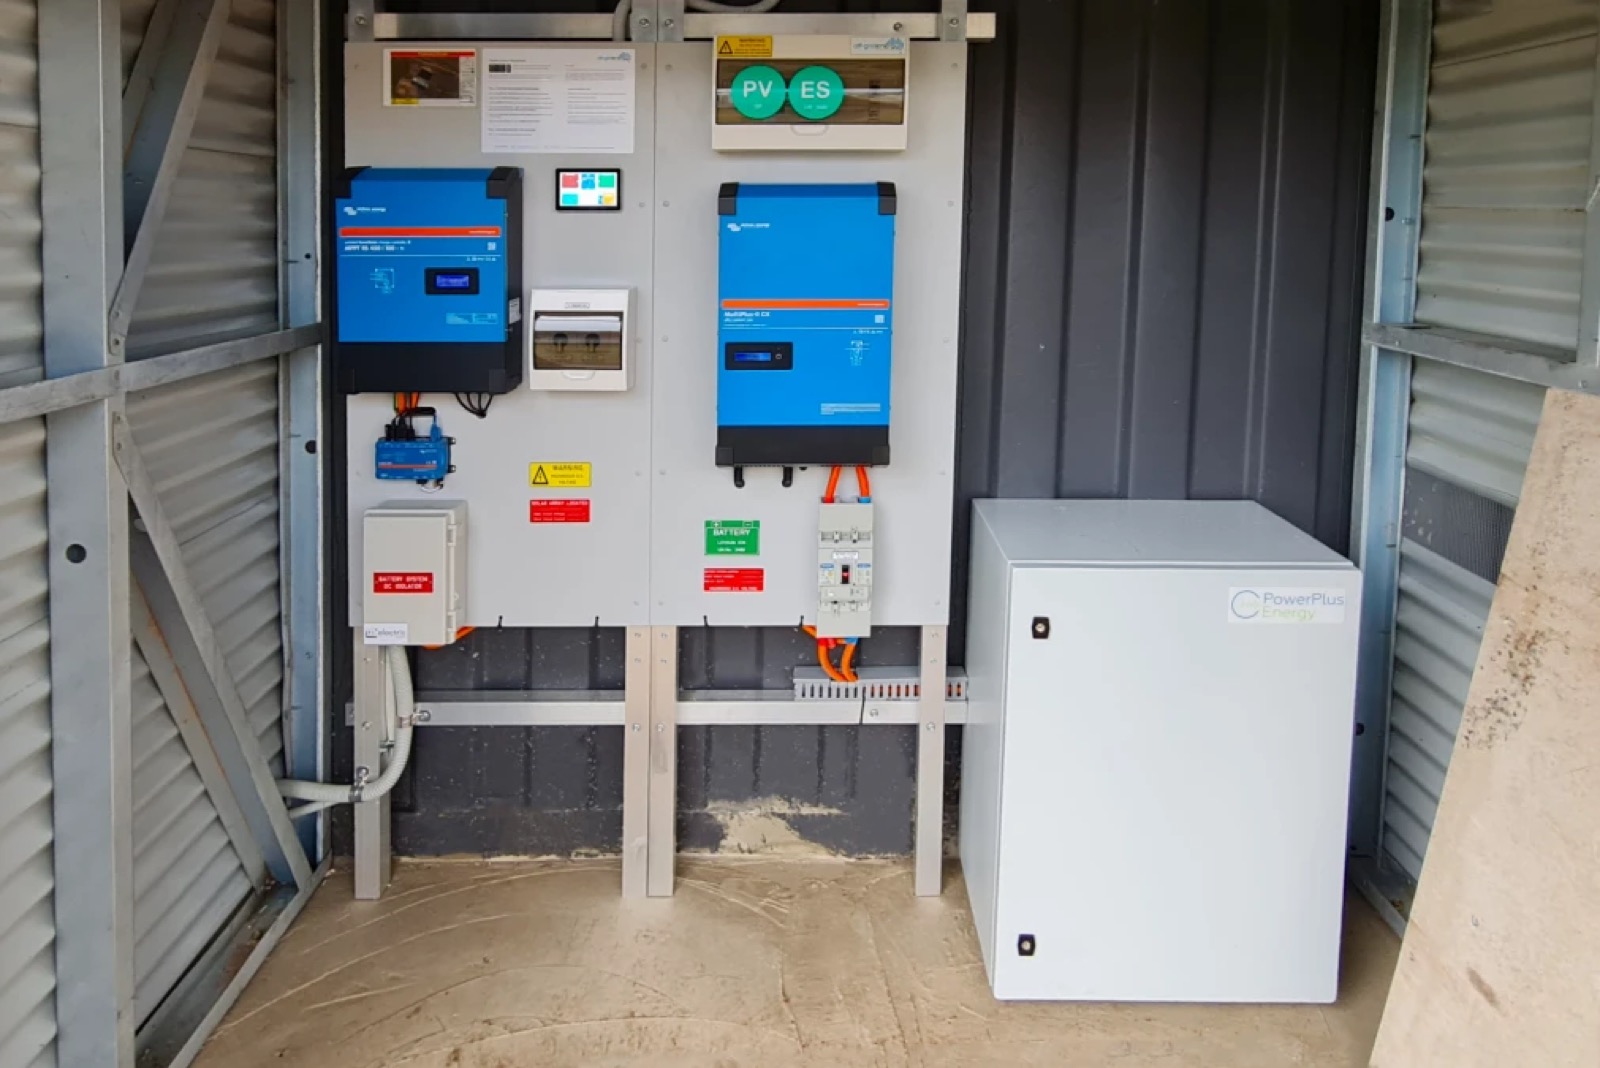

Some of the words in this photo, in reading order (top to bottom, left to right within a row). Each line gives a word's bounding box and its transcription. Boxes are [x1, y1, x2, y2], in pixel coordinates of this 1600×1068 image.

[743, 80, 773, 98] PV
[800, 81, 831, 99] ES
[713, 528, 751, 536] BATTERY
[1263, 592, 1345, 605] PowerPlus
[1262, 605, 1316, 621] Energy
